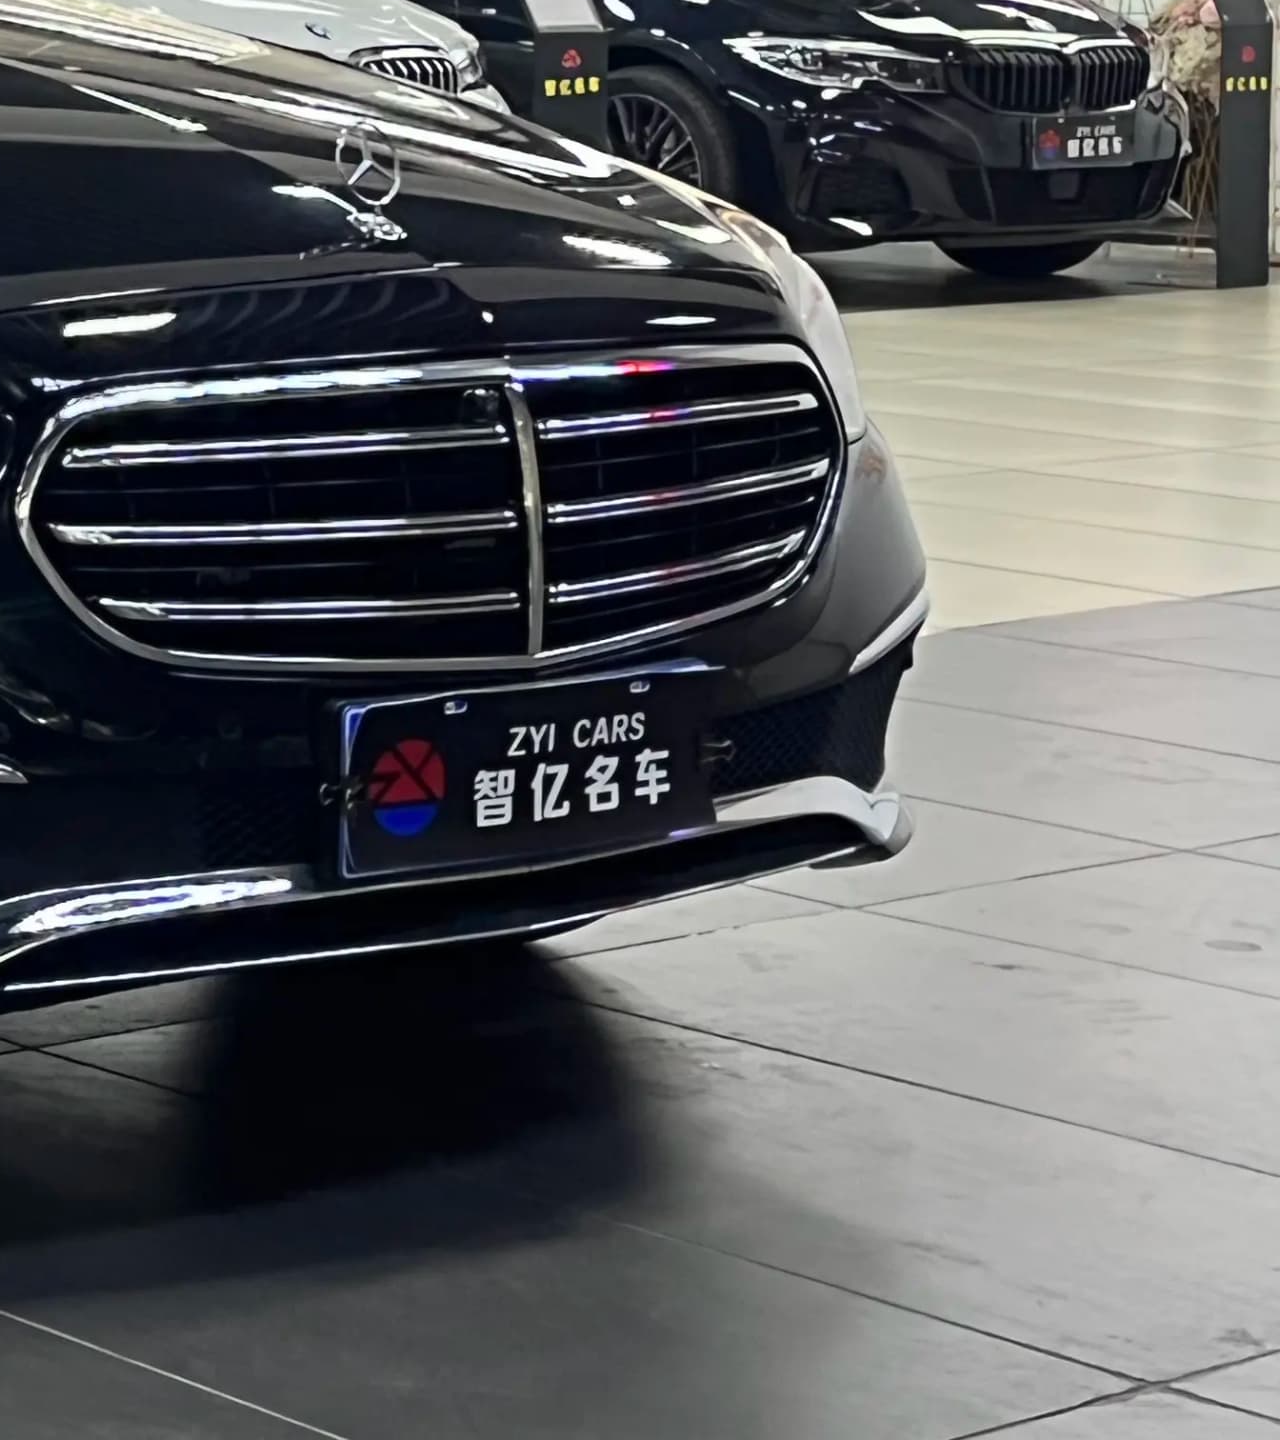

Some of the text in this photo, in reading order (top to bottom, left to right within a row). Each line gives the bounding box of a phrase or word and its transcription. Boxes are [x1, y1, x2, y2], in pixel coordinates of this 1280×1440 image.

[507, 712, 646, 757] ZYI CARS
[473, 747, 671, 828] 智亿名车
